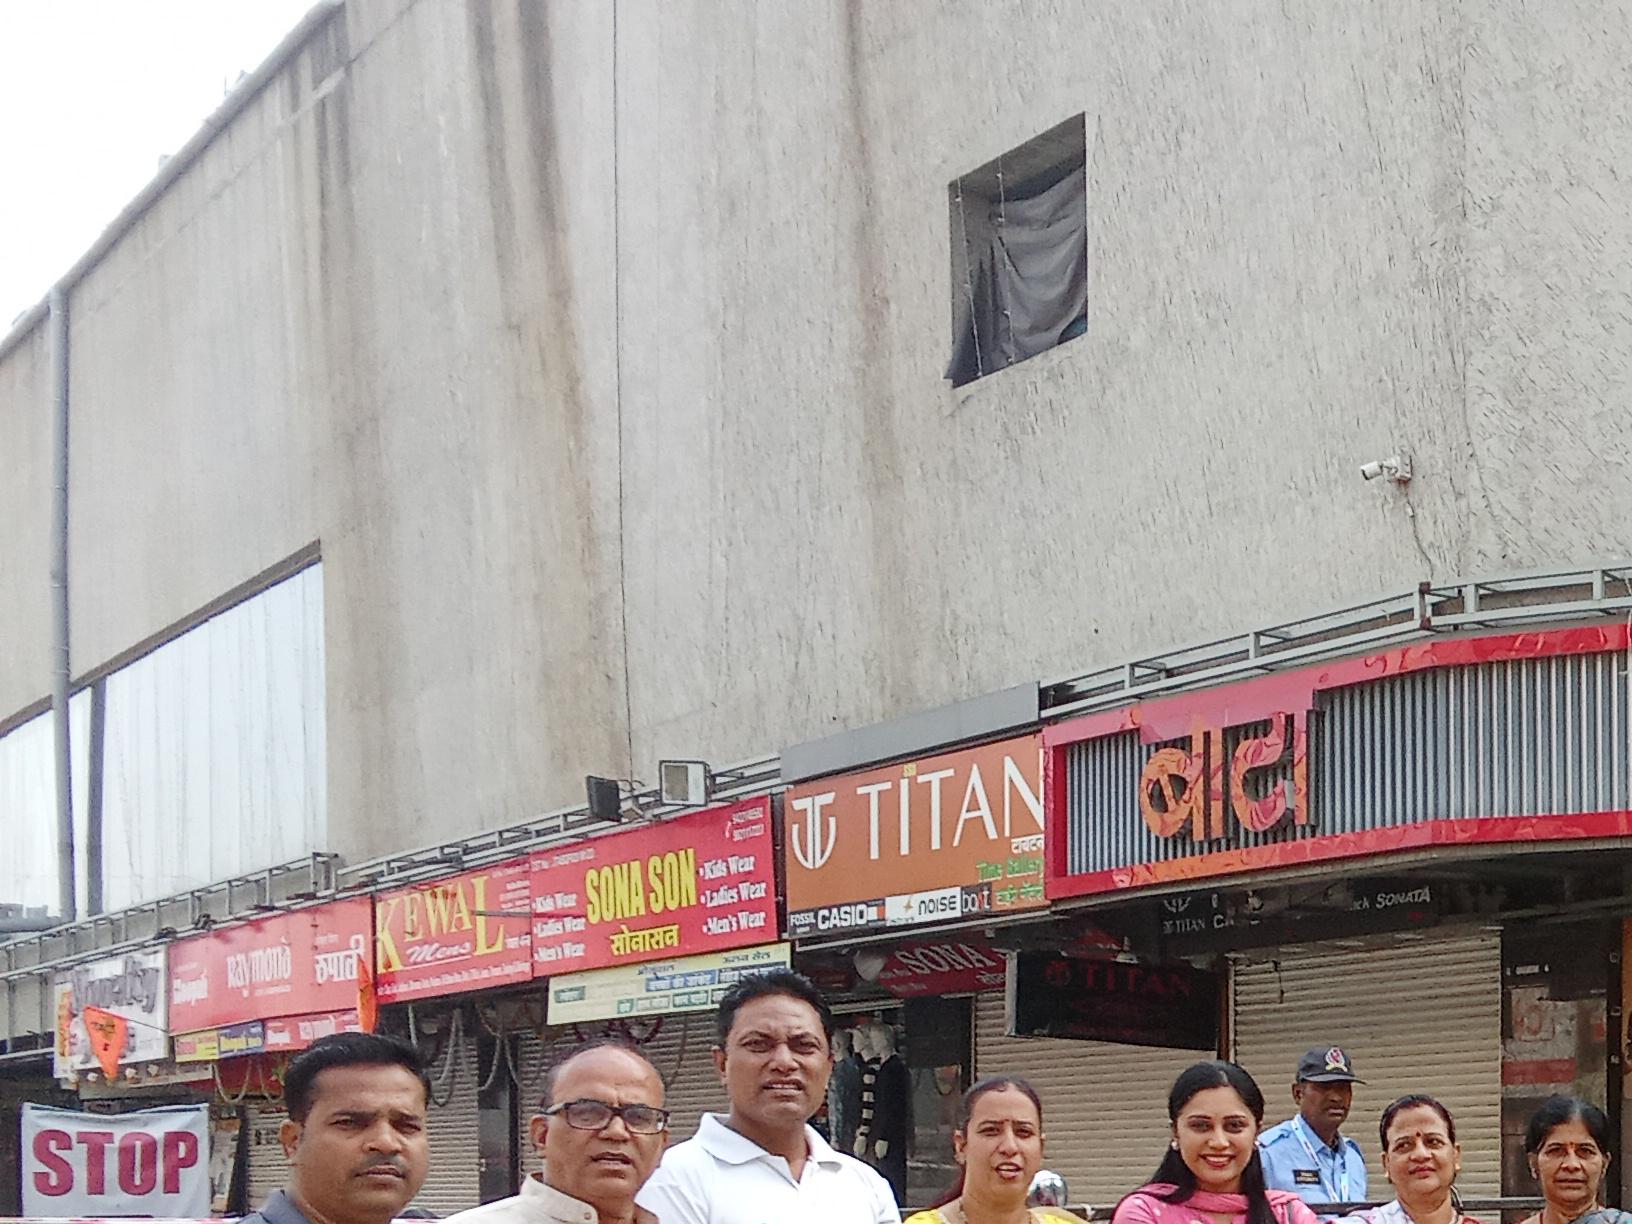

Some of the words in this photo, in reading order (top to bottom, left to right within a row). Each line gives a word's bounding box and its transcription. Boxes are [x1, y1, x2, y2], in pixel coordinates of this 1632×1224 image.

[856, 748, 1045, 860] TITAN
[585, 860, 646, 925] SONA
[648, 848, 697, 914] SON
[818, 904, 868, 930] CASIO
[376, 875, 504, 975] KEWAL
[895, 943, 997, 975] SONA
[32, 1129, 199, 1197] STOP
